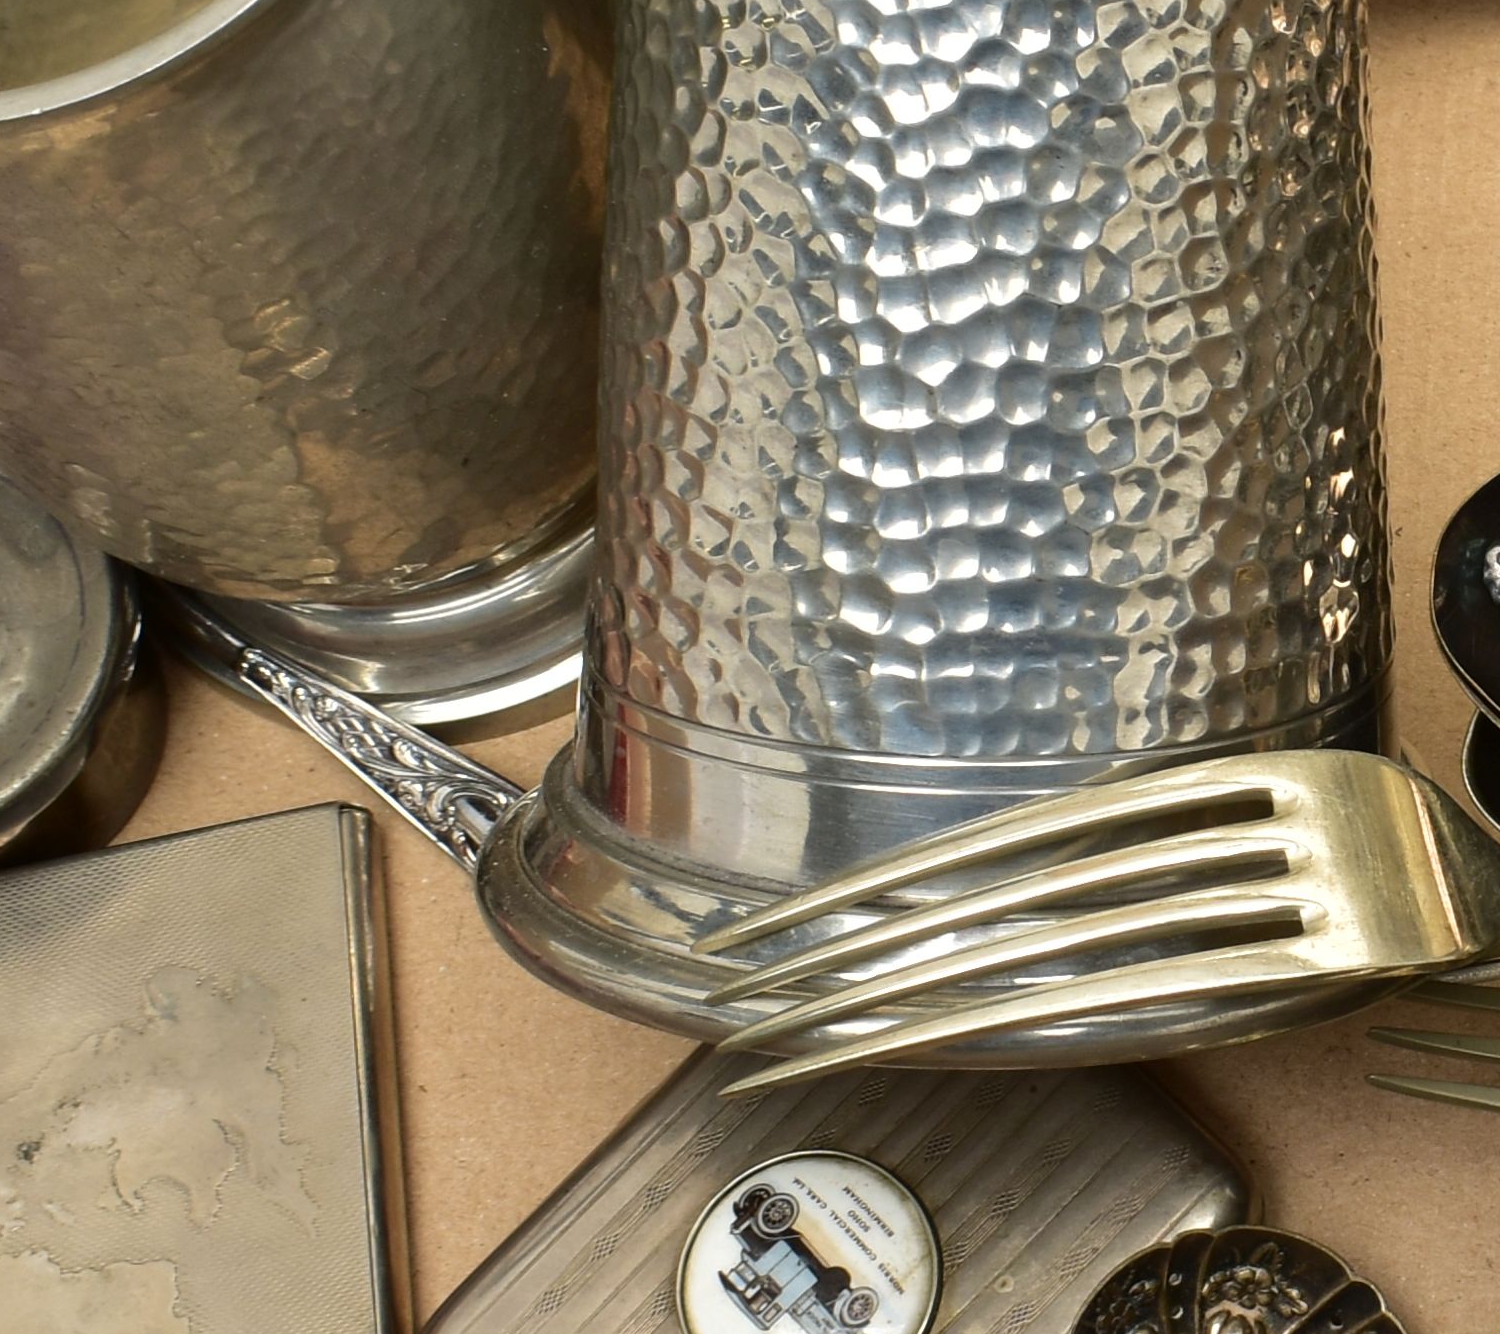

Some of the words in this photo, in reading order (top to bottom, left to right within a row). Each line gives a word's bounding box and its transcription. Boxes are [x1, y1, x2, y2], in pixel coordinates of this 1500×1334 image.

[842, 1185, 894, 1238] BIRMINGHAM
[847, 1209, 871, 1233] SOHO
[828, 1209, 878, 1262] COMMERCIAL
[878, 1263, 904, 1295] MORRIS
